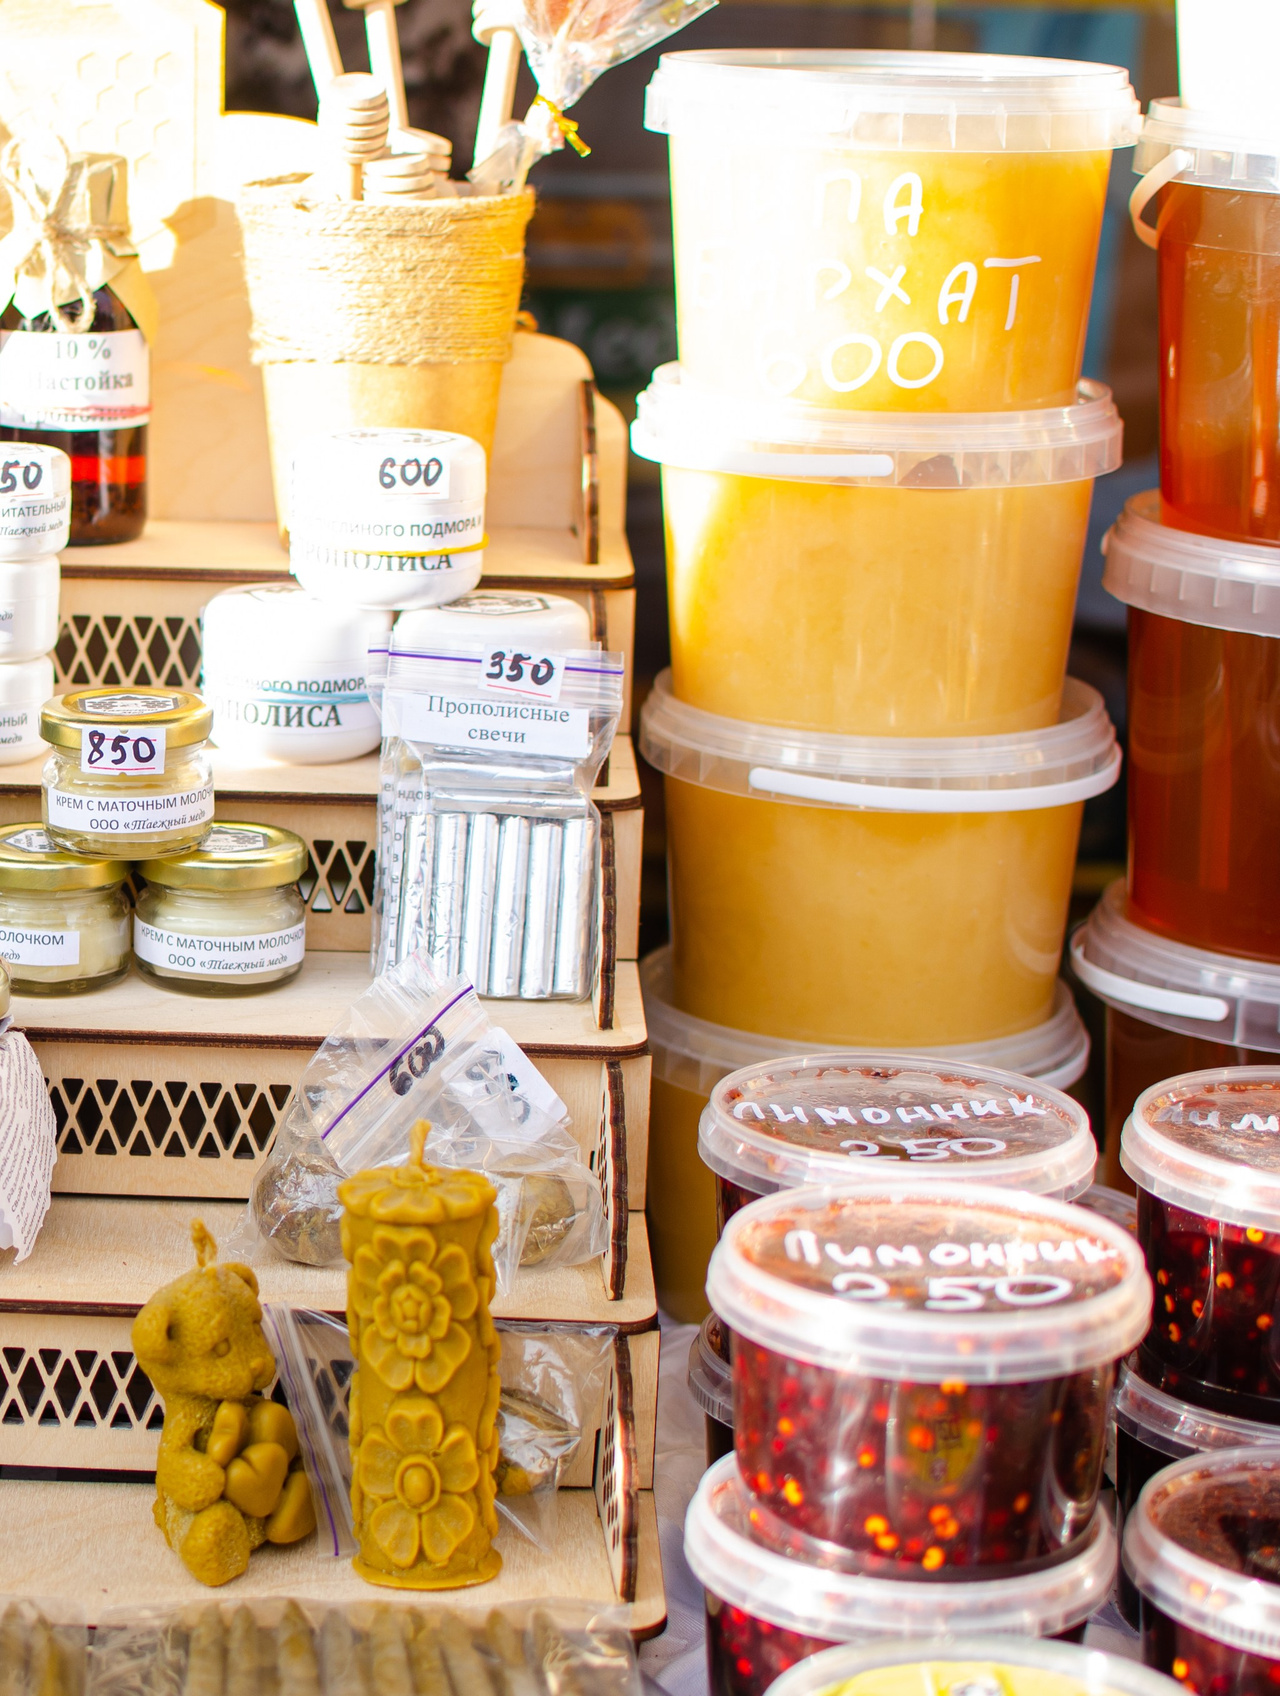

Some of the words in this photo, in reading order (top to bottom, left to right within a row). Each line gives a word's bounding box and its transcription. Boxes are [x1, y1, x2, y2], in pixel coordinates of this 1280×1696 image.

[87, 337, 112, 360] %
[378, 456, 444, 490] 600
[410, 515, 478, 539] ПОДМОРА
[485, 650, 554, 686] 350
[297, 676, 367, 694] ПОДМОР
[427, 694, 570, 723] Прополисные
[467, 727, 526, 744] свечи
[87, 730, 156, 766] 850
[56, 794, 84, 811] КРЕМ
[86, 798, 95, 812] С
[98, 795, 177, 813] МАТОЧНЫМ
[89, 818, 120, 830] ООО
[123, 813, 188, 832] «Таежный
[140, 925, 164, 944] КРЕМ
[166, 934, 174, 947] С
[176, 936, 256, 953] МАТОЧНЫМ
[167, 953, 196, 968] ООО
[199, 957, 265, 973] «Таежный
[266, 953, 288, 968] мед»
[839, 1136, 1007, 1161] 250
[831, 1271, 1075, 1311] 250
